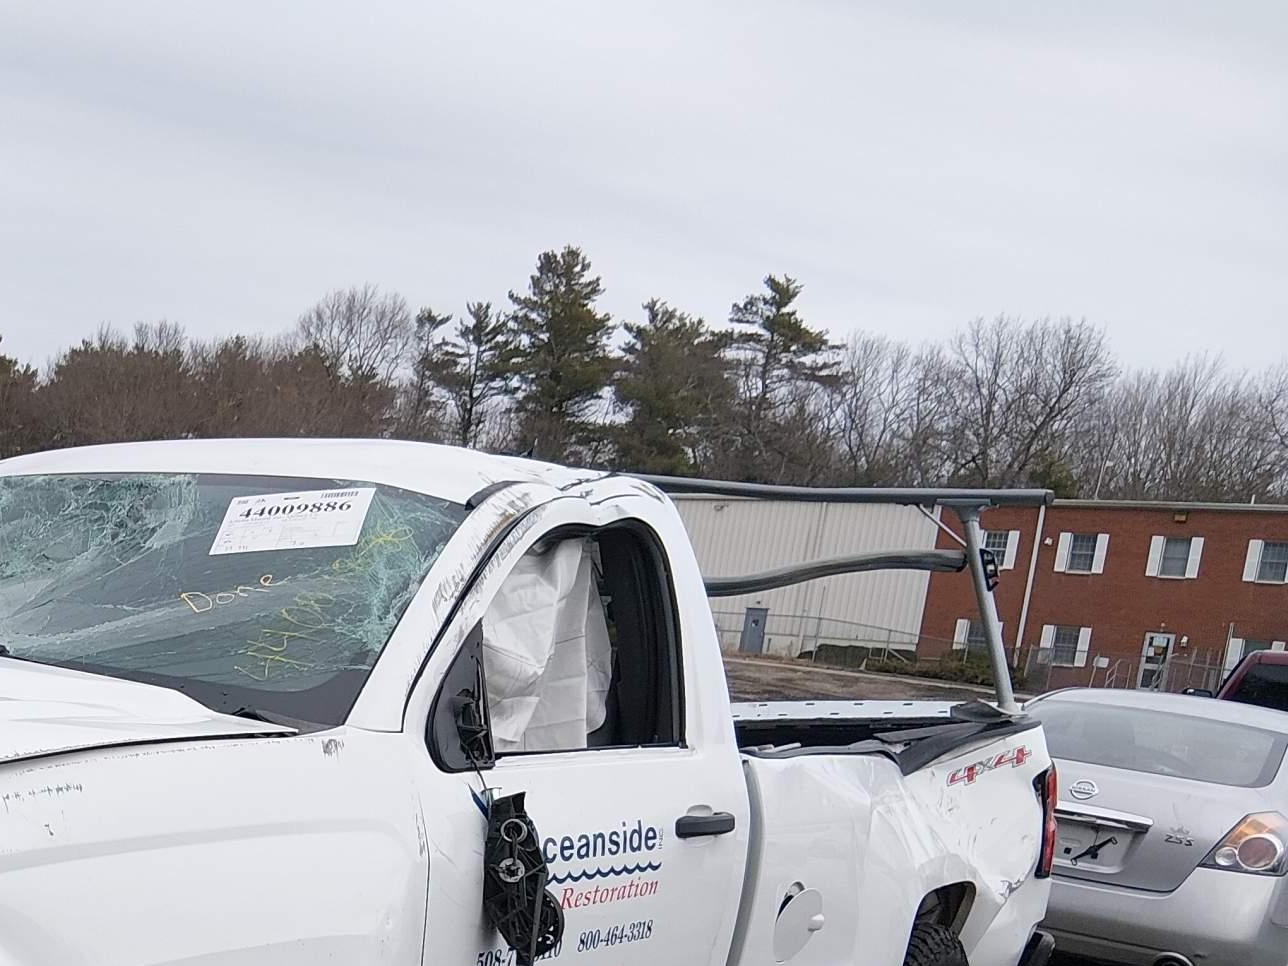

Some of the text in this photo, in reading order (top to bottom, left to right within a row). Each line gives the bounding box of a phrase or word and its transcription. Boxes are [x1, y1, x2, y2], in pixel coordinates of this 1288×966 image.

[239, 501, 352, 519] 44009886
[180, 574, 282, 613] Done
[543, 820, 657, 864] ceanside
[561, 878, 659, 911] Restoration
[577, 920, 653, 953] 800-464-3318
